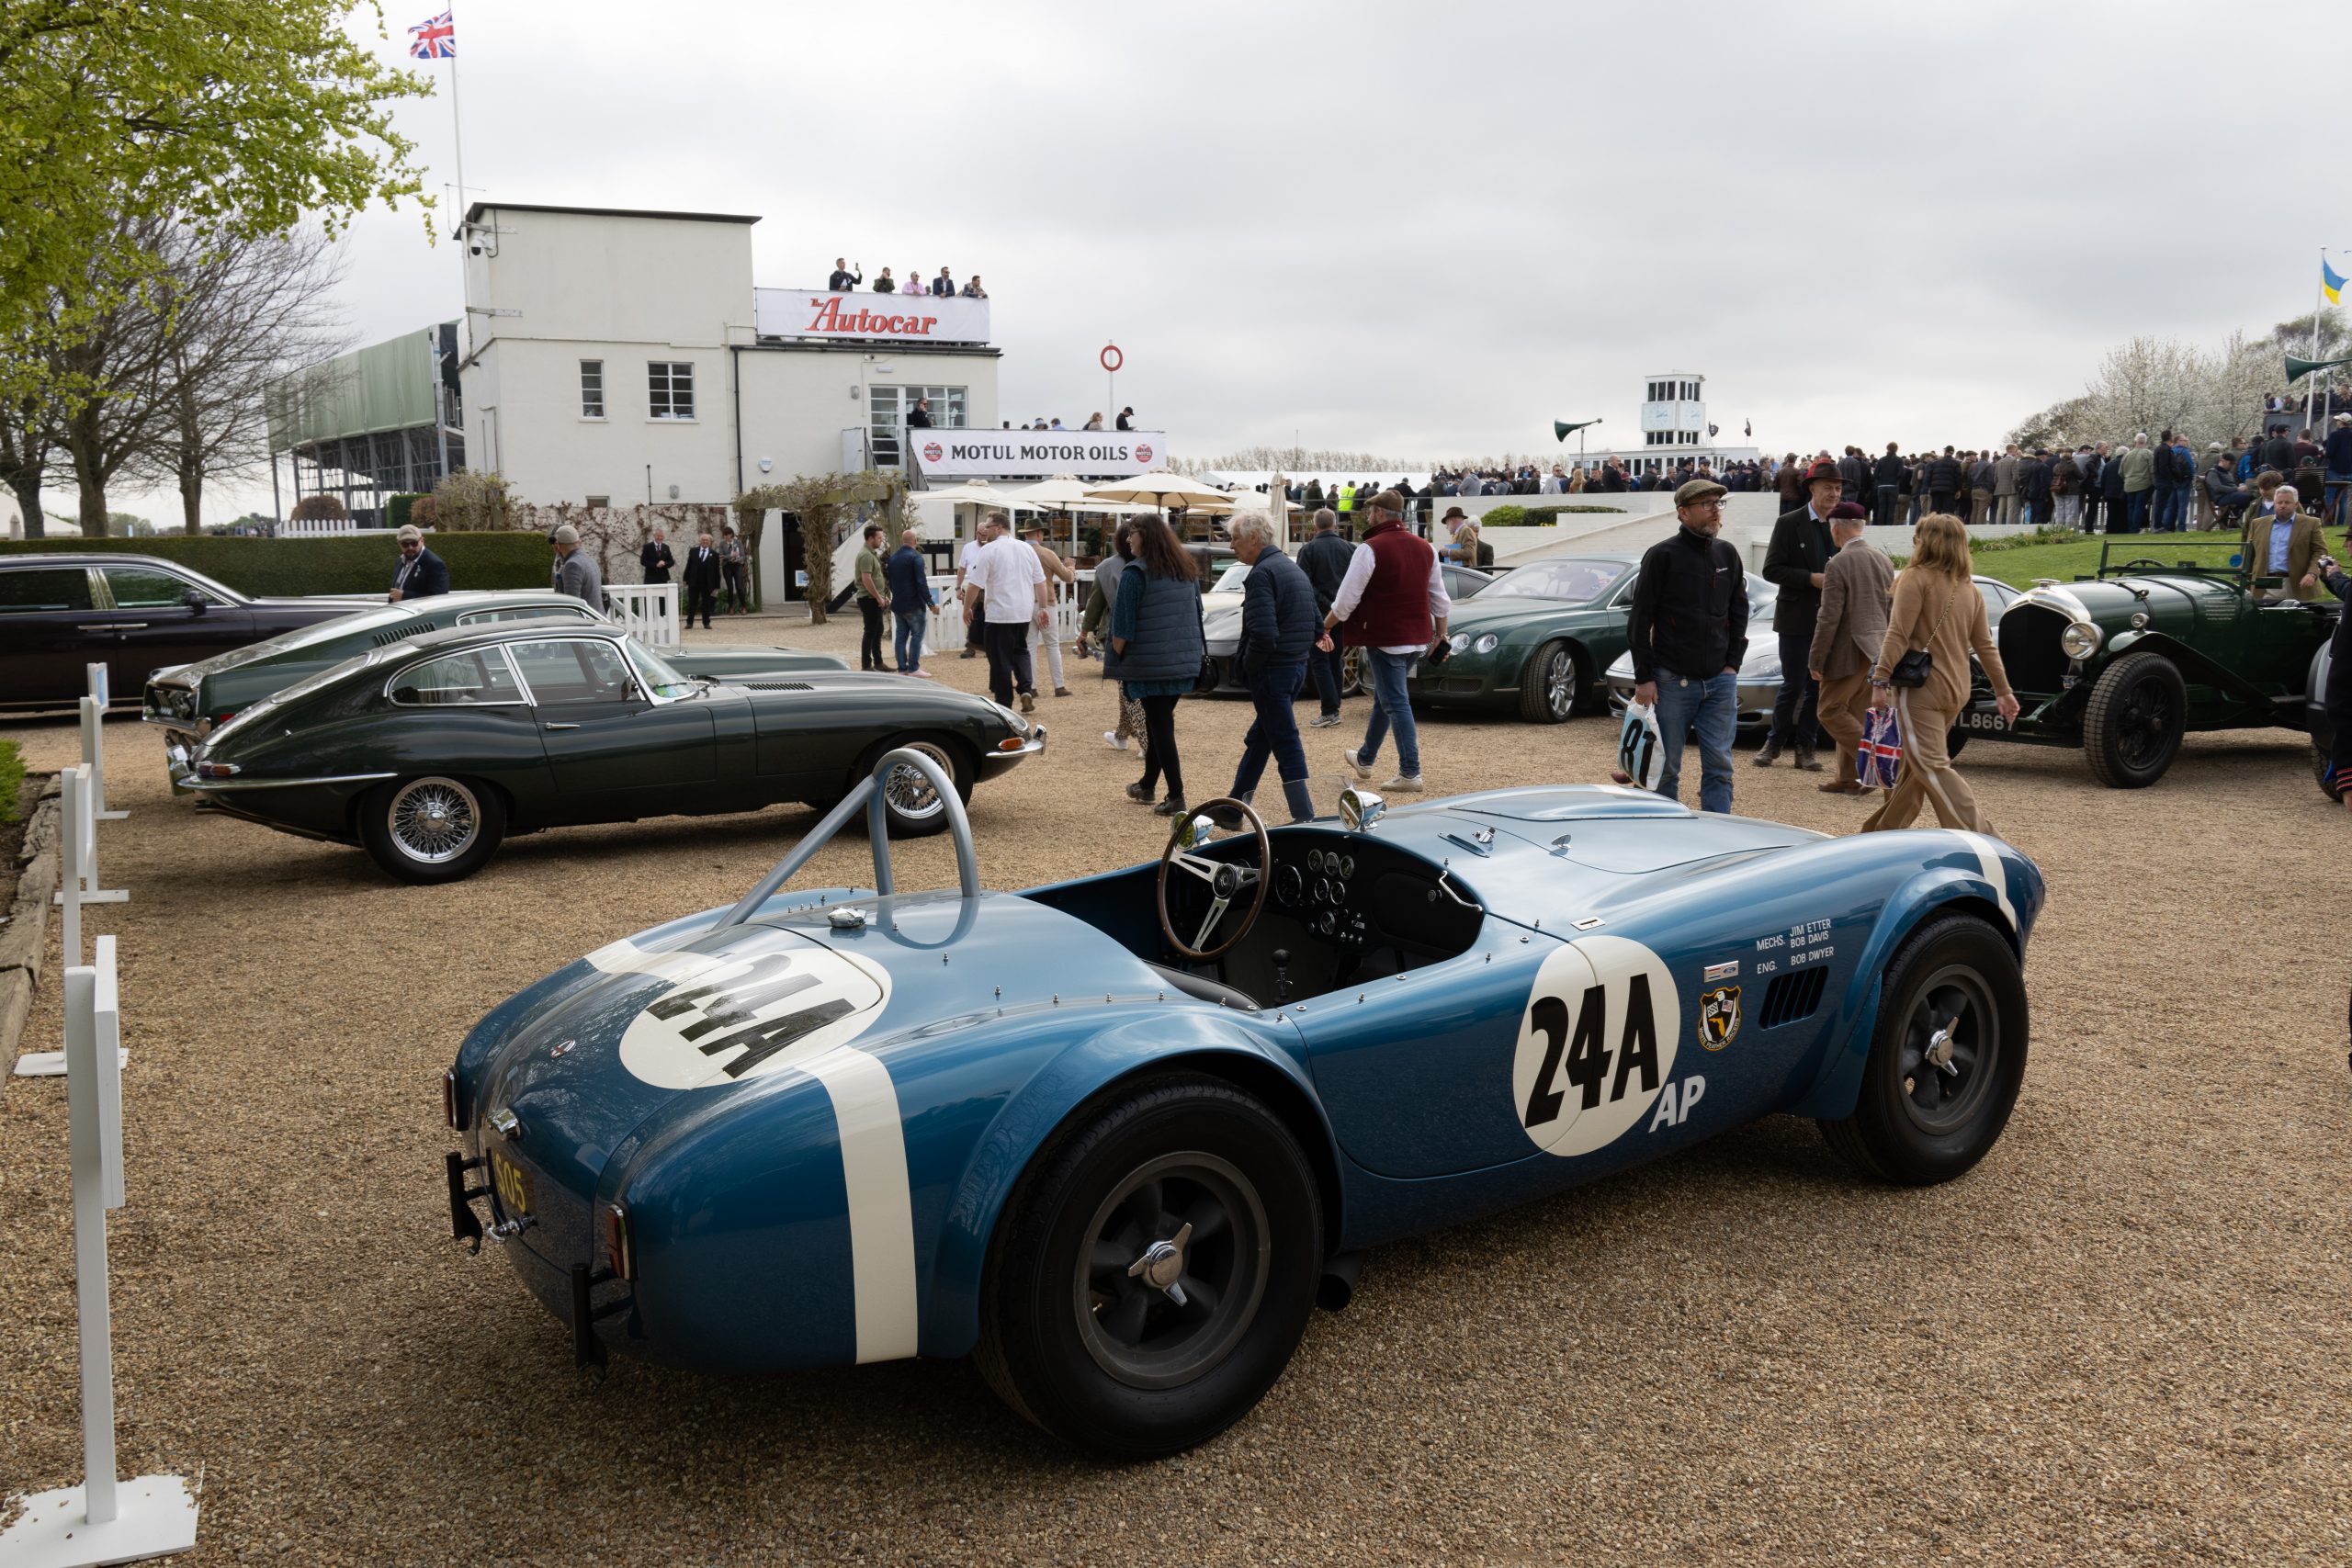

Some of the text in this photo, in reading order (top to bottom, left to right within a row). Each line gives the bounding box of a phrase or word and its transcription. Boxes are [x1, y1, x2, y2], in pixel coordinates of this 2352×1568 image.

[805, 297, 938, 334] Autocar
[951, 445, 1128, 461] MOTUL MOTOR OILS
[1790, 919, 1831, 937] JIM ETTER
[1790, 931, 1829, 948] BOB DAVIS
[1757, 935, 1785, 951] MECHS.
[1757, 946, 1834, 974] ENG. BOB DWYER
[1525, 973, 1659, 1129] 24A
[1648, 1075, 1706, 1134] AP
